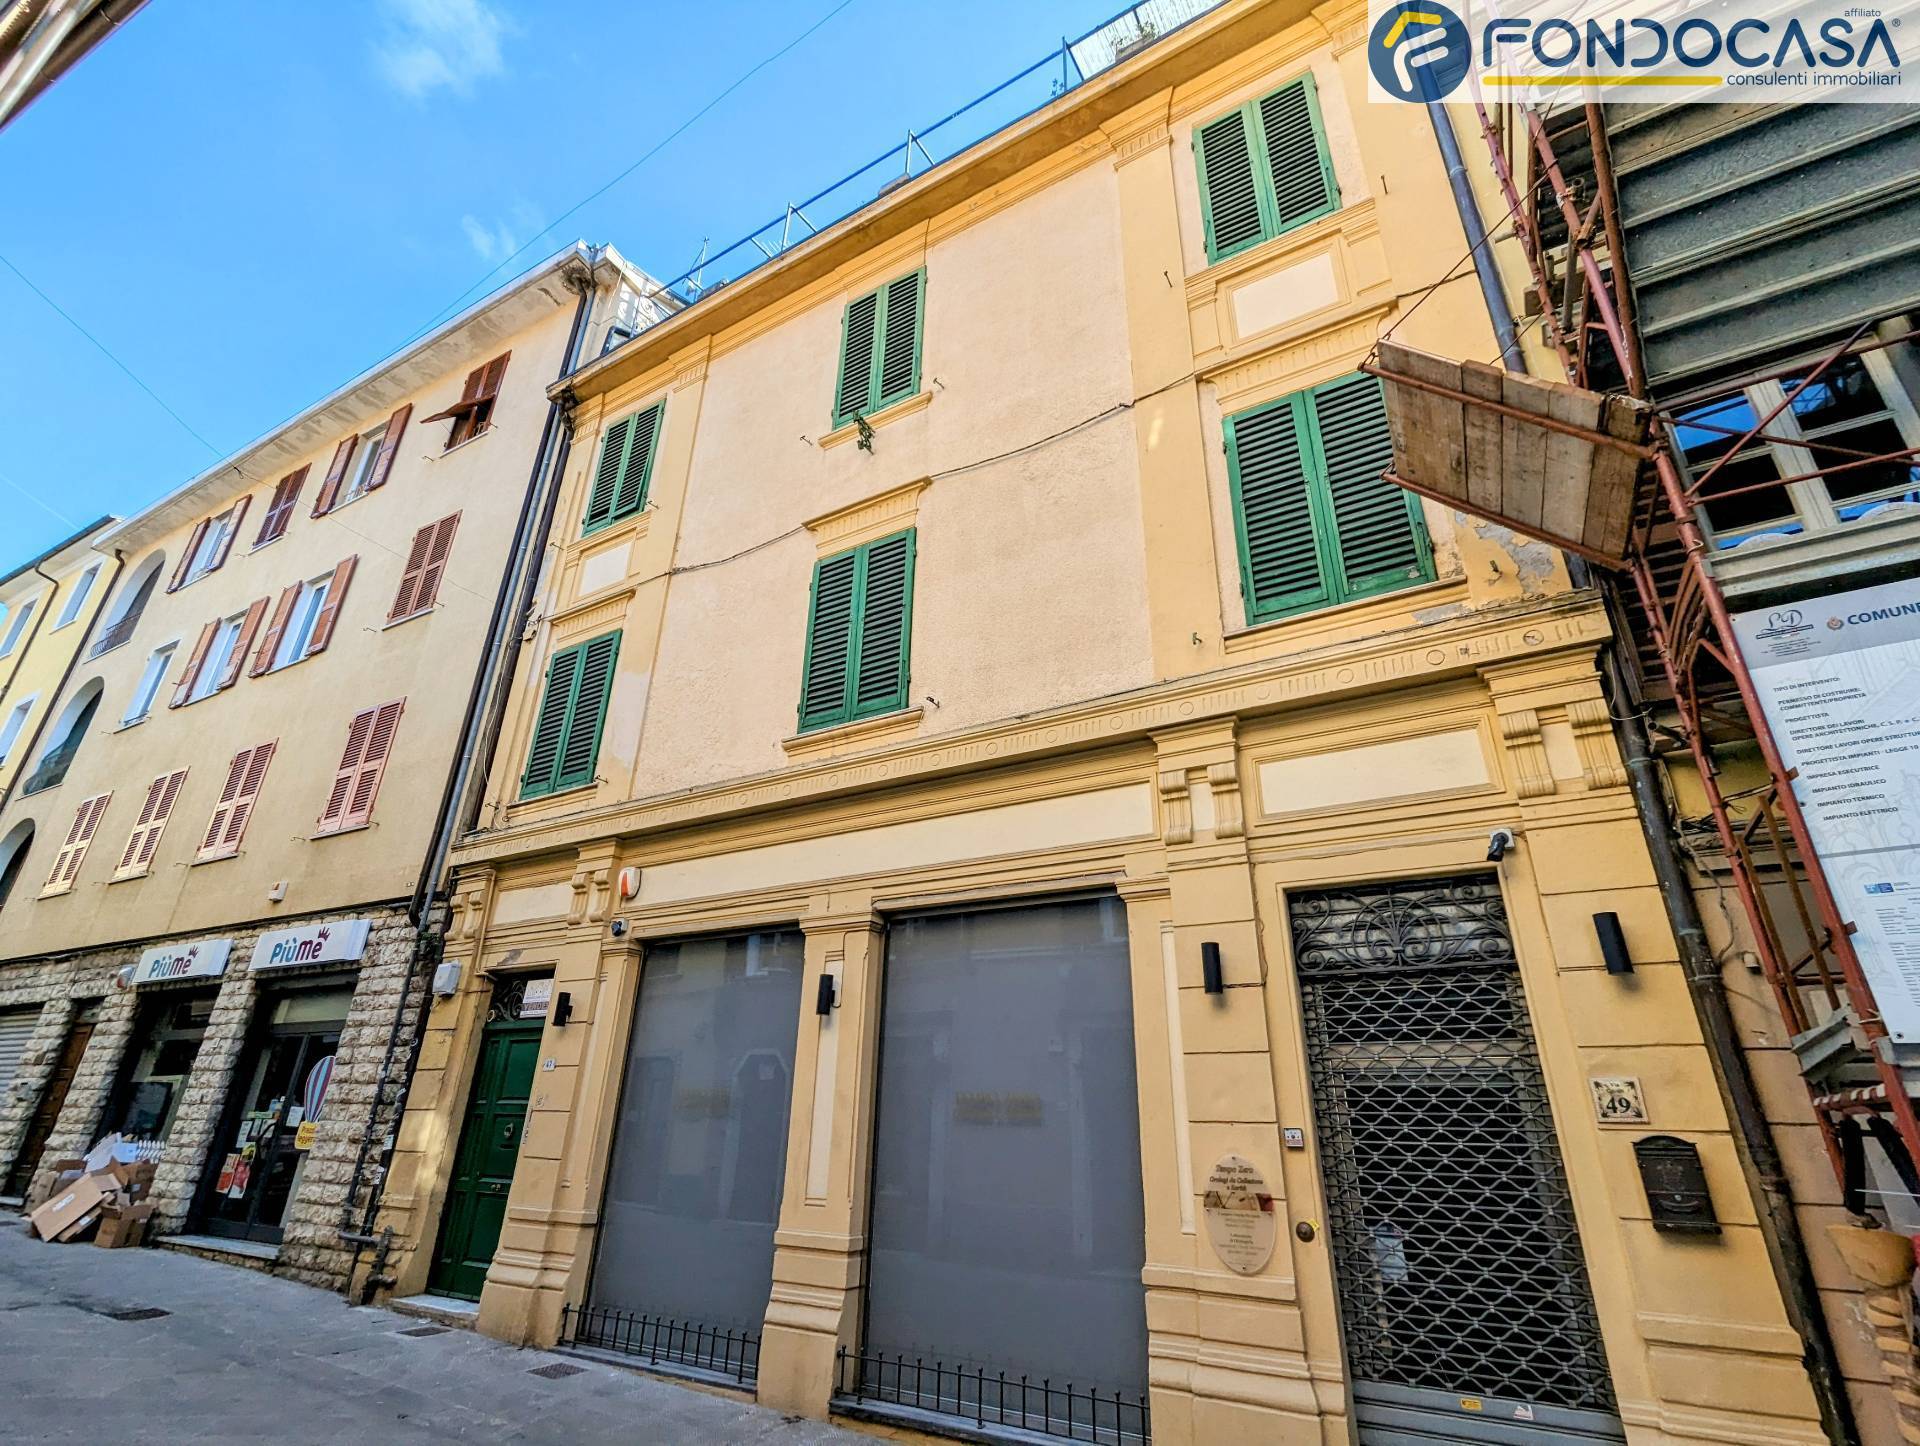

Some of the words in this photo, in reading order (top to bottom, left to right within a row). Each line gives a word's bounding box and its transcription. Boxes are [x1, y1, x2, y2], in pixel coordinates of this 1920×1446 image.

[1773, 685, 1789, 693] TIPO
[1778, 695, 1813, 705] PERMESSO
[1785, 712, 1830, 723] PROGETTISTA
[1789, 725, 1825, 735] DIRETTORE
[1840, 719, 1865, 728] LAVORI
[1792, 733, 1814, 742] OPERE
[1796, 745, 1834, 755] DIRETTORE
[1834, 740, 1860, 749] LAVORI
[1860, 736, 1883, 744] OPERE
[1801, 756, 1847, 767] PROGETTISTA
[1848, 750, 1881, 760] IMPIANTI
[1806, 771, 1837, 780] IMPRESA
[1838, 765, 1881, 775] ESECUTRICE
[1812, 784, 1847, 793] IMPIANTO
[1847, 778, 1887, 788] IDRAULICO
[1817, 798, 1852, 807] IMPIANTO
[1852, 793, 1885, 802] TERMICO
[1823, 812, 1859, 821] IMPIANTO
[1860, 806, 1899, 816] ELETTRICO
[1606, 1097, 1631, 1114] 49
